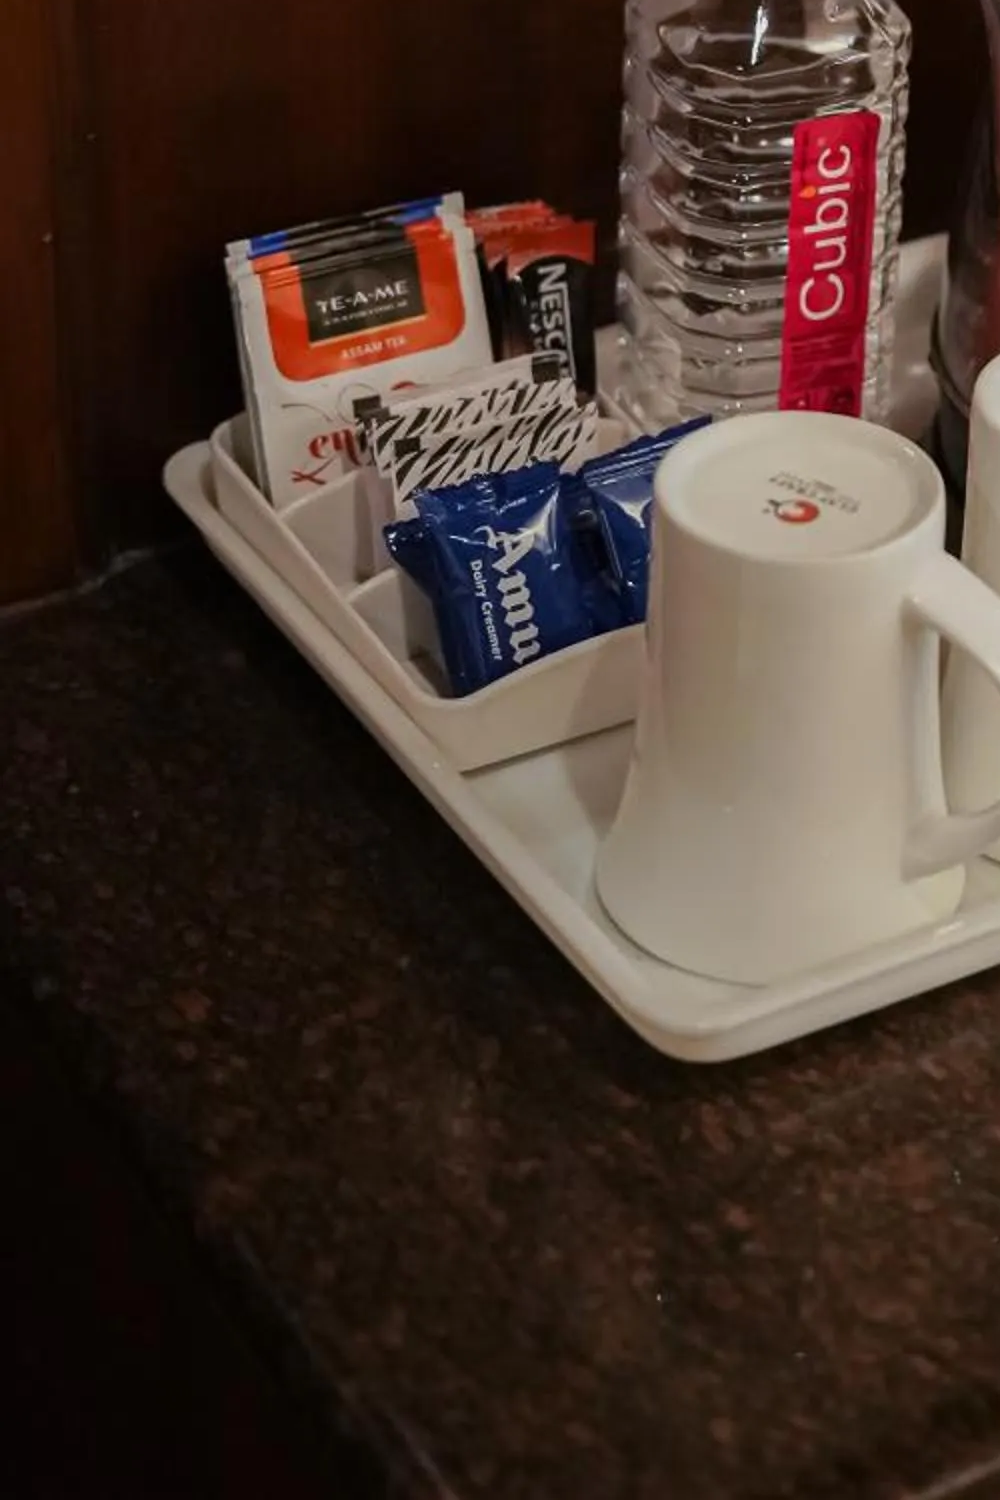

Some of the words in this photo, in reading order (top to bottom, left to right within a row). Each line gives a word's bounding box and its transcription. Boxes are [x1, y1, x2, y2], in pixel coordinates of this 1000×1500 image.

[800, 144, 851, 321] Cubic
[315, 280, 409, 314] TE-A-ME
[537, 262, 575, 378] NESC
[469, 558, 487, 599] Dairy
[480, 601, 503, 662] Creamer
[474, 525, 542, 666] Amu
